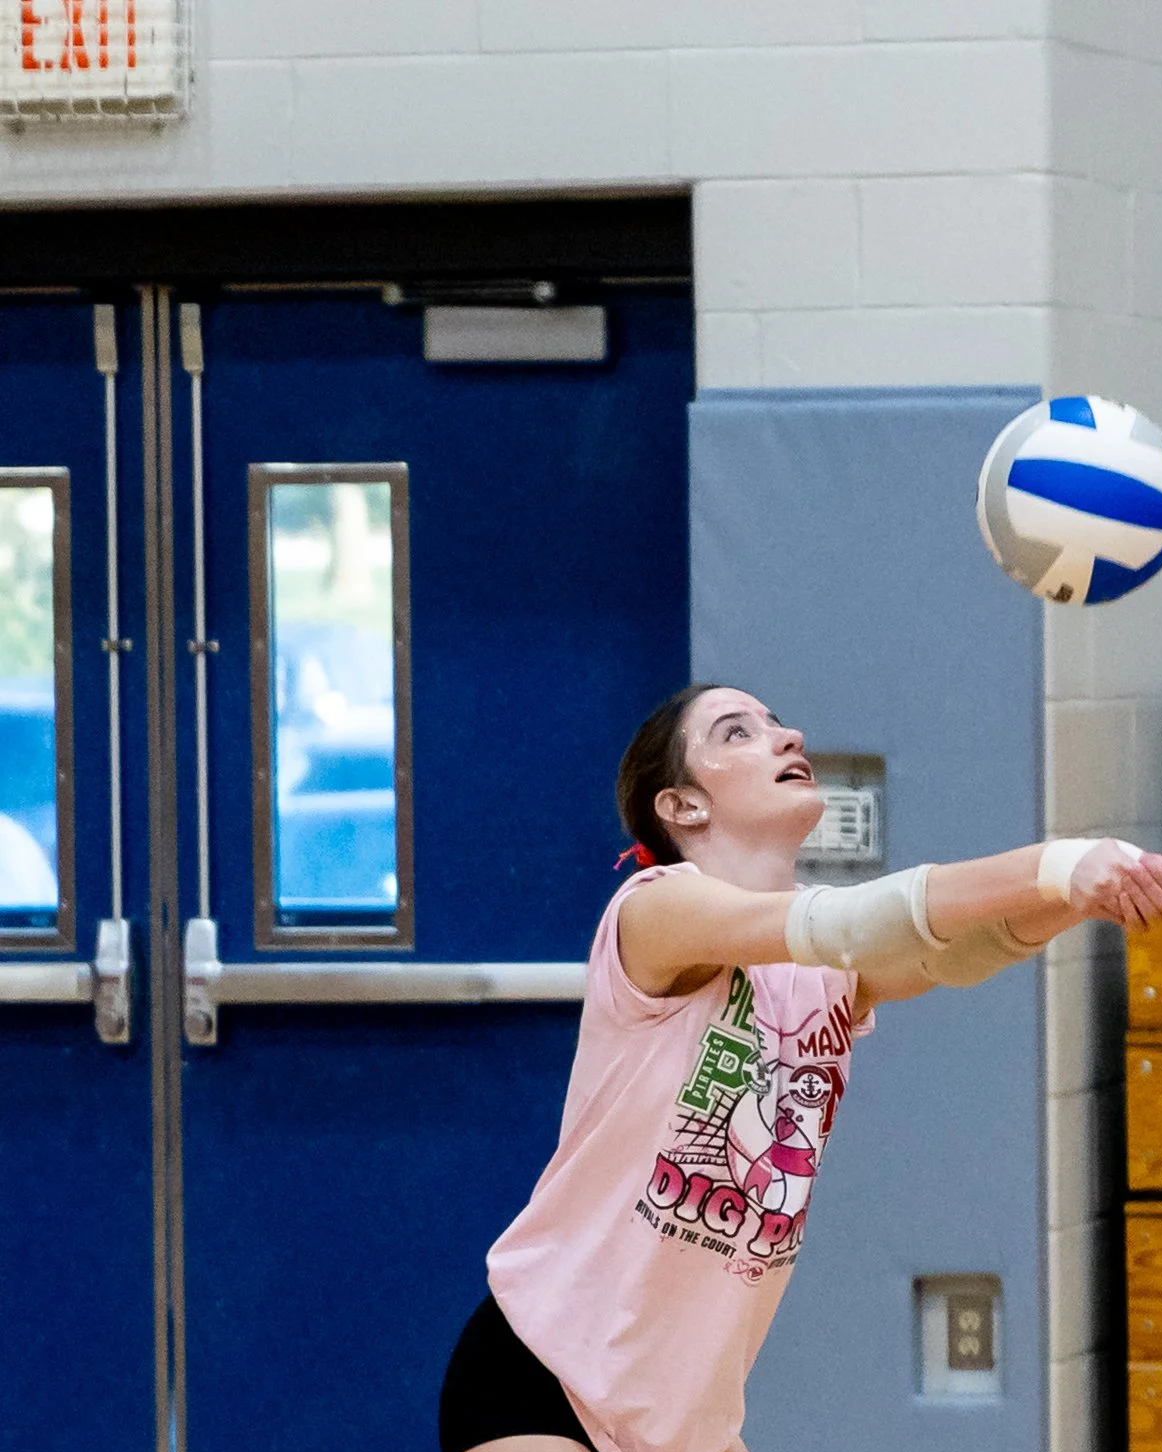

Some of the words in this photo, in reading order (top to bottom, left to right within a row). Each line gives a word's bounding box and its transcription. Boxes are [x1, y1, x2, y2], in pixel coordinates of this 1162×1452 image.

[691, 1038, 724, 1100] PIRATES
[647, 1152, 748, 1238] DIG
[634, 1199, 660, 1230] RIVALS
[661, 1223, 678, 1238] ON
[679, 1228, 701, 1244] THE
[701, 1235, 737, 1259] COURT
